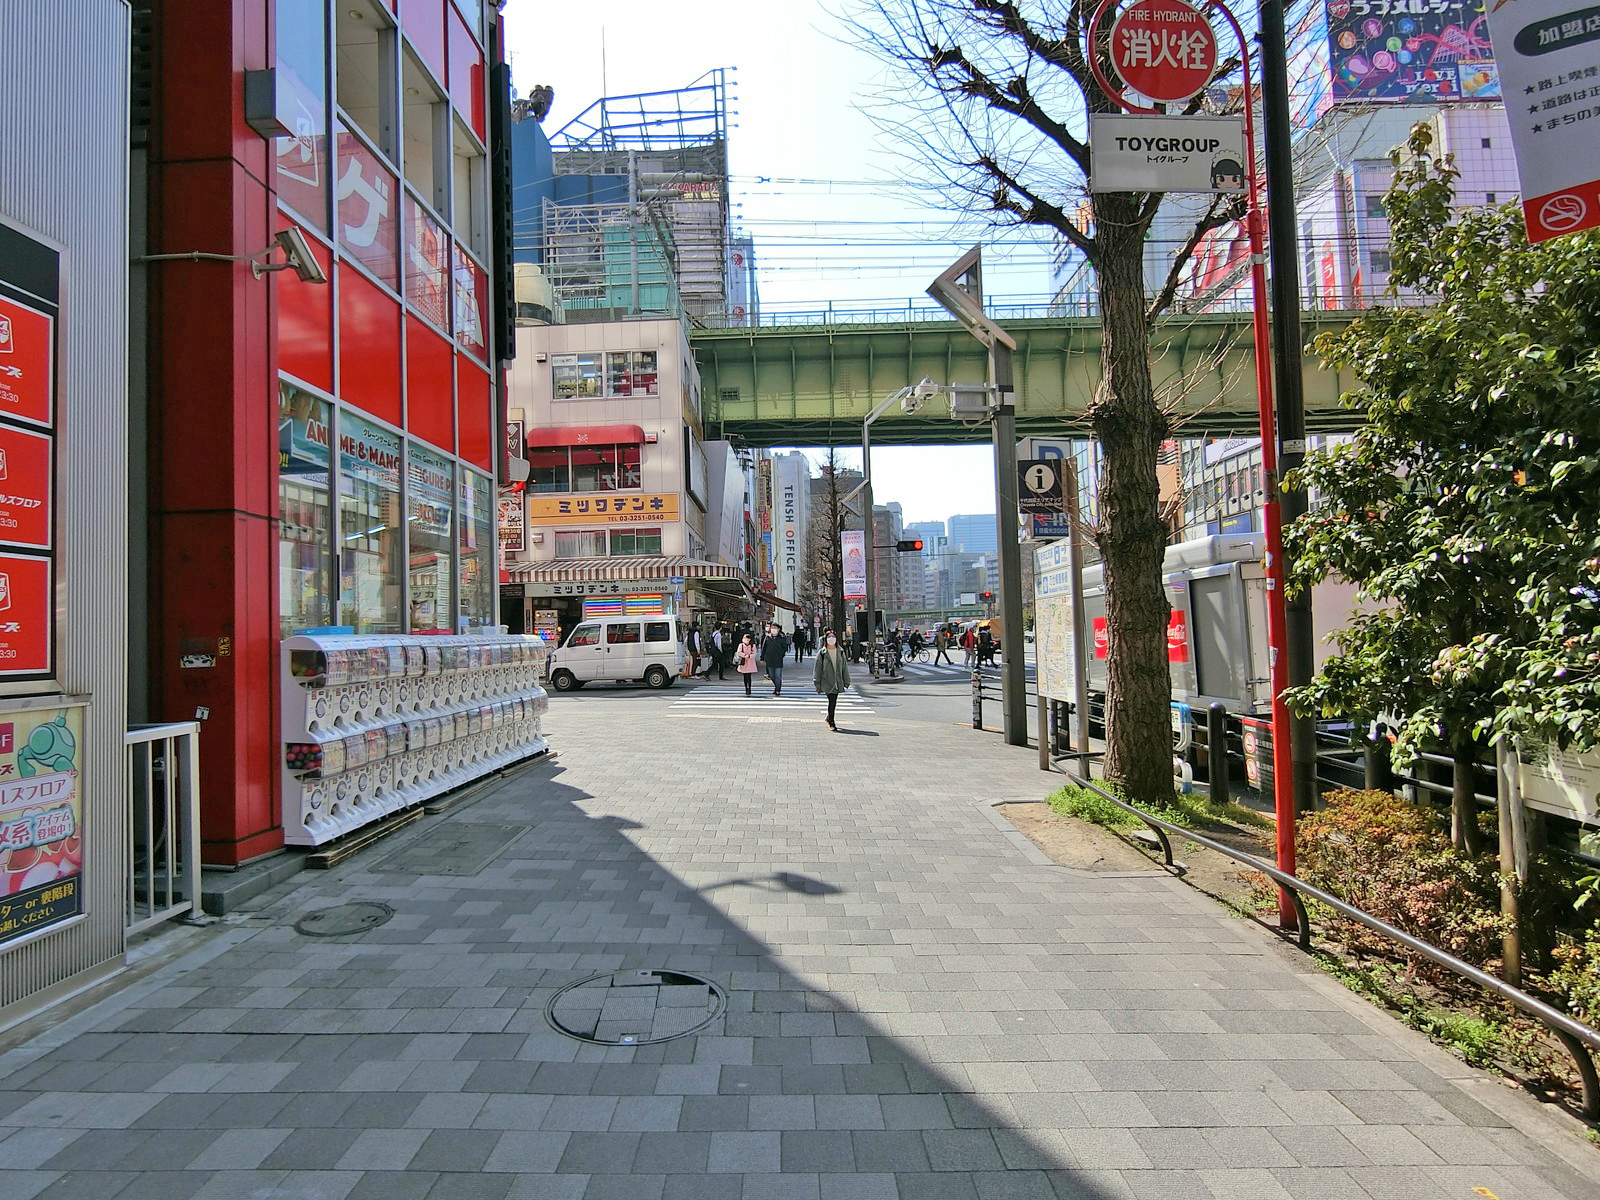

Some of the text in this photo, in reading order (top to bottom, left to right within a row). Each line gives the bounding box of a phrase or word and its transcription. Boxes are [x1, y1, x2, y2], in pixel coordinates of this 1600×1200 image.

[1128, 9, 1198, 23] FIRE HYDRANT
[1121, 28, 1209, 70] 消火栓
[1115, 137, 1220, 153] TOYGROUP
[1146, 155, 1190, 164] トイグループ
[357, 441, 367, 460] &
[559, 497, 664, 514] ミツワデンキ
[619, 514, 664, 522] 03-3251-0540
[553, 585, 620, 595] ミツワデンキ
[36, 811, 71, 828] アイテム
[25, 898, 39, 909] or
[41, 882, 74, 906] 裏階段
